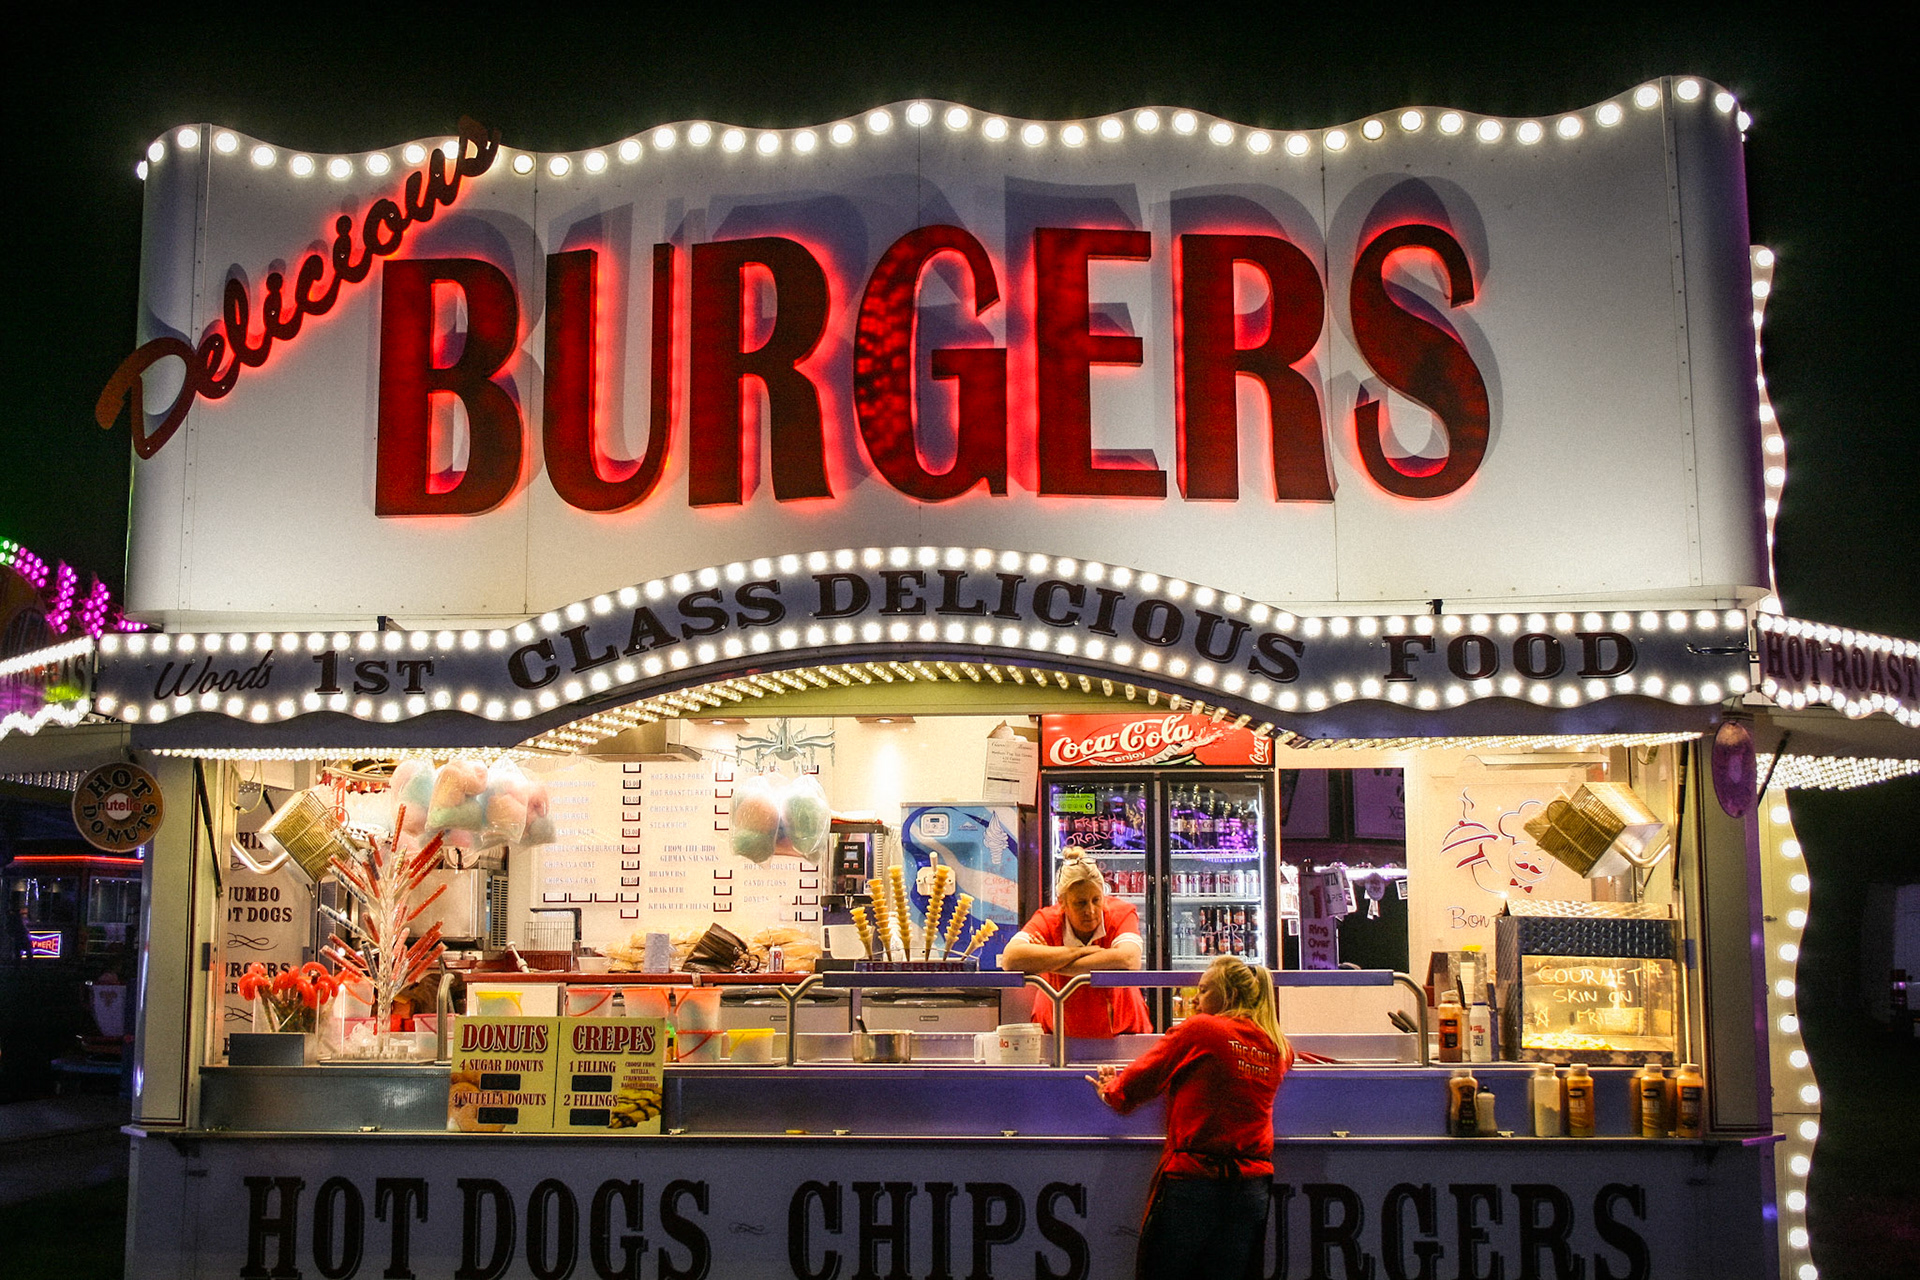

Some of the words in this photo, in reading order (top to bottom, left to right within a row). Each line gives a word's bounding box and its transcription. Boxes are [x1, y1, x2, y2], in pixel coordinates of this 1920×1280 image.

[95, 115, 498, 460] Delicious
[375, 222, 1491, 518] BURGERS
[312, 650, 434, 695] 1ST
[507, 579, 786, 689] CLASS
[813, 570, 1304, 683] DELICIOUS
[1382, 632, 1637, 682] FOOD
[1764, 631, 1822, 685] HOT
[1829, 643, 1920, 699] ROAST
[1050, 713, 1196, 766] Coca-Cola
[1113, 750, 1147, 763] enjoy
[86, 769, 153, 798] HOT
[98, 798, 141, 812] nutella
[82, 804, 158, 843] DONUTS
[247, 907, 293, 923] DOGS
[1447, 906, 1490, 929] Bon
[1552, 988, 1598, 1003] SKIN
[1608, 989, 1632, 1004] ON
[1576, 1008, 1630, 1026] FRIES
[461, 1023, 548, 1053] DONUTS
[572, 1024, 656, 1055] CREPES
[459, 1059, 467, 1071] 4
[469, 1059, 502, 1071] SUGAR
[505, 1060, 544, 1072] DONUTS
[569, 1061, 575, 1072] 1
[578, 1061, 616, 1073] FILLING
[454, 1092, 461, 1104] 4
[463, 1092, 504, 1104] NUTELLA
[507, 1094, 547, 1106] DONUTS
[563, 1094, 571, 1106] 2
[574, 1095, 618, 1107] FILLINGS
[240, 1176, 430, 1280] HOT
[454, 1178, 713, 1280] DOGS
[788, 1180, 1091, 1280] CHIPS
[1264, 1182, 1653, 1280] URGERS
